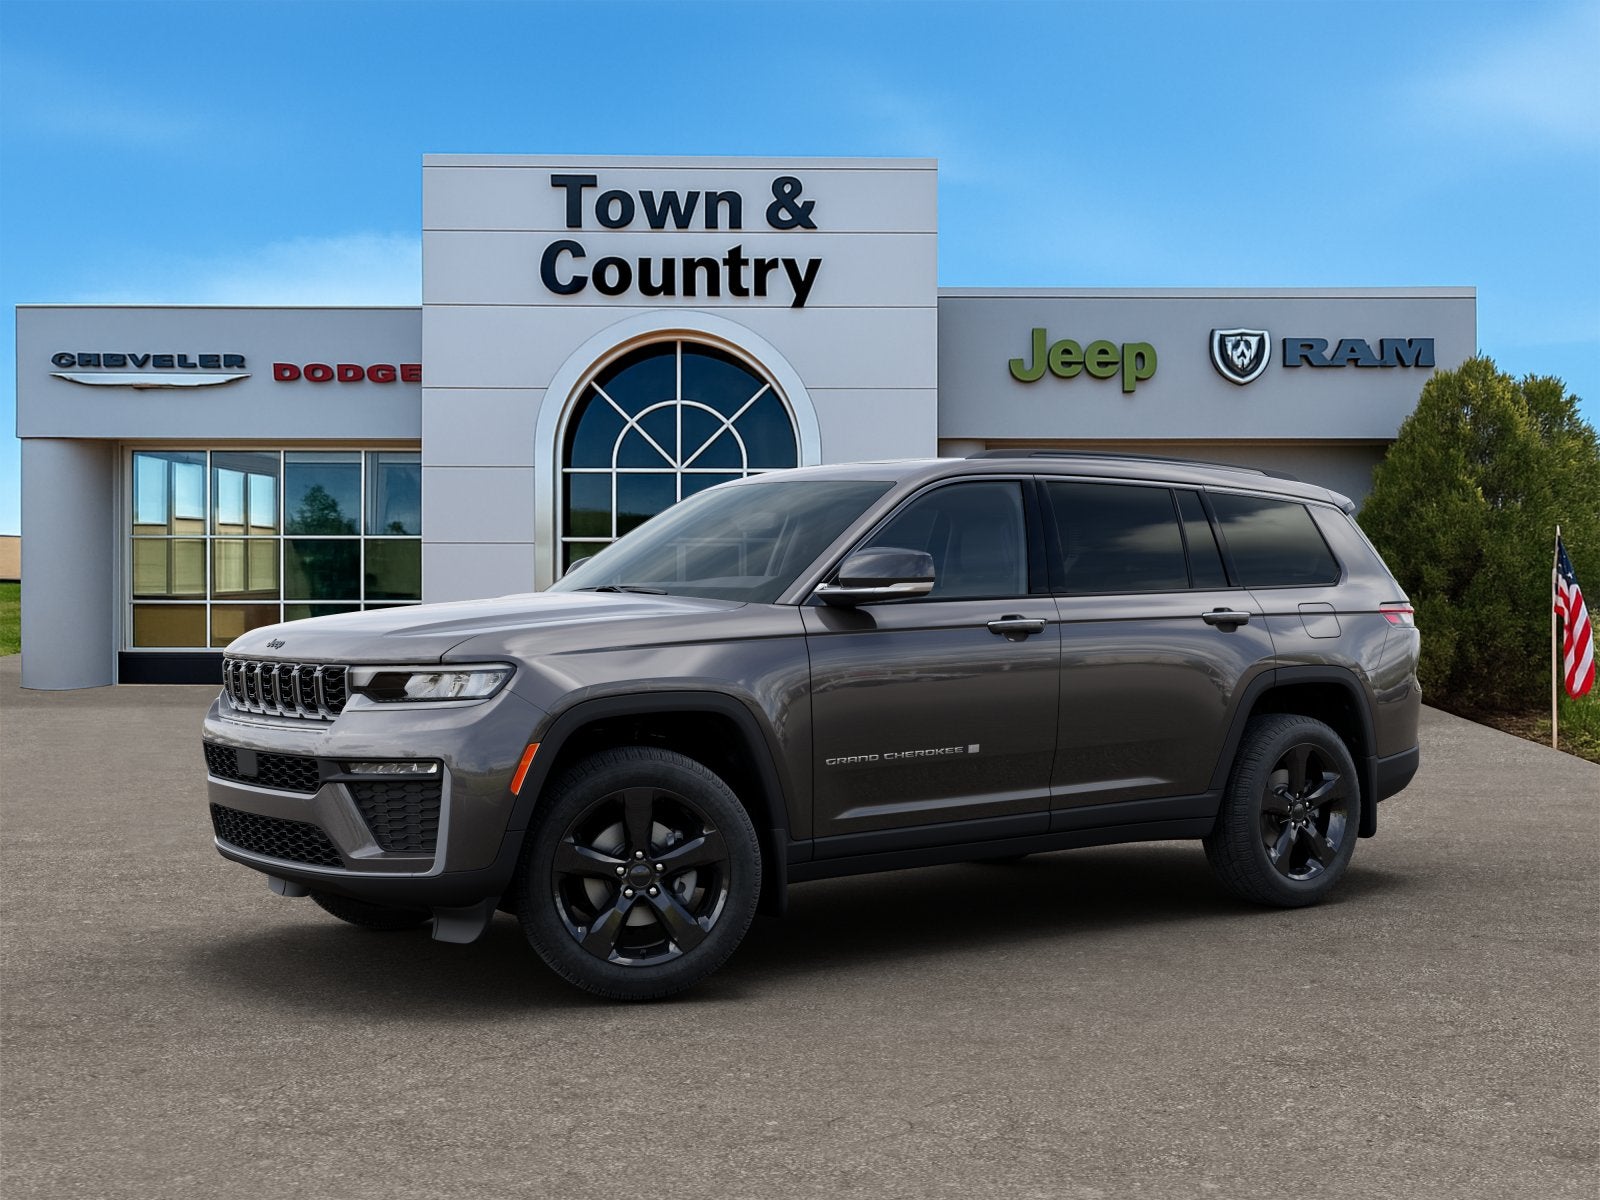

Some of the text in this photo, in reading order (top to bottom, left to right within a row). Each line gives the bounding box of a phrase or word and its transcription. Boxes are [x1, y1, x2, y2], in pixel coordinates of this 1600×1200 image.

[551, 174, 818, 230] Town &
[540, 239, 823, 308] Country
[272, 362, 422, 383] DODGE
[1008, 327, 1157, 393] Jeep
[1282, 337, 1436, 368] RAM
[825, 746, 964, 766] GRAND CHEROKEE
